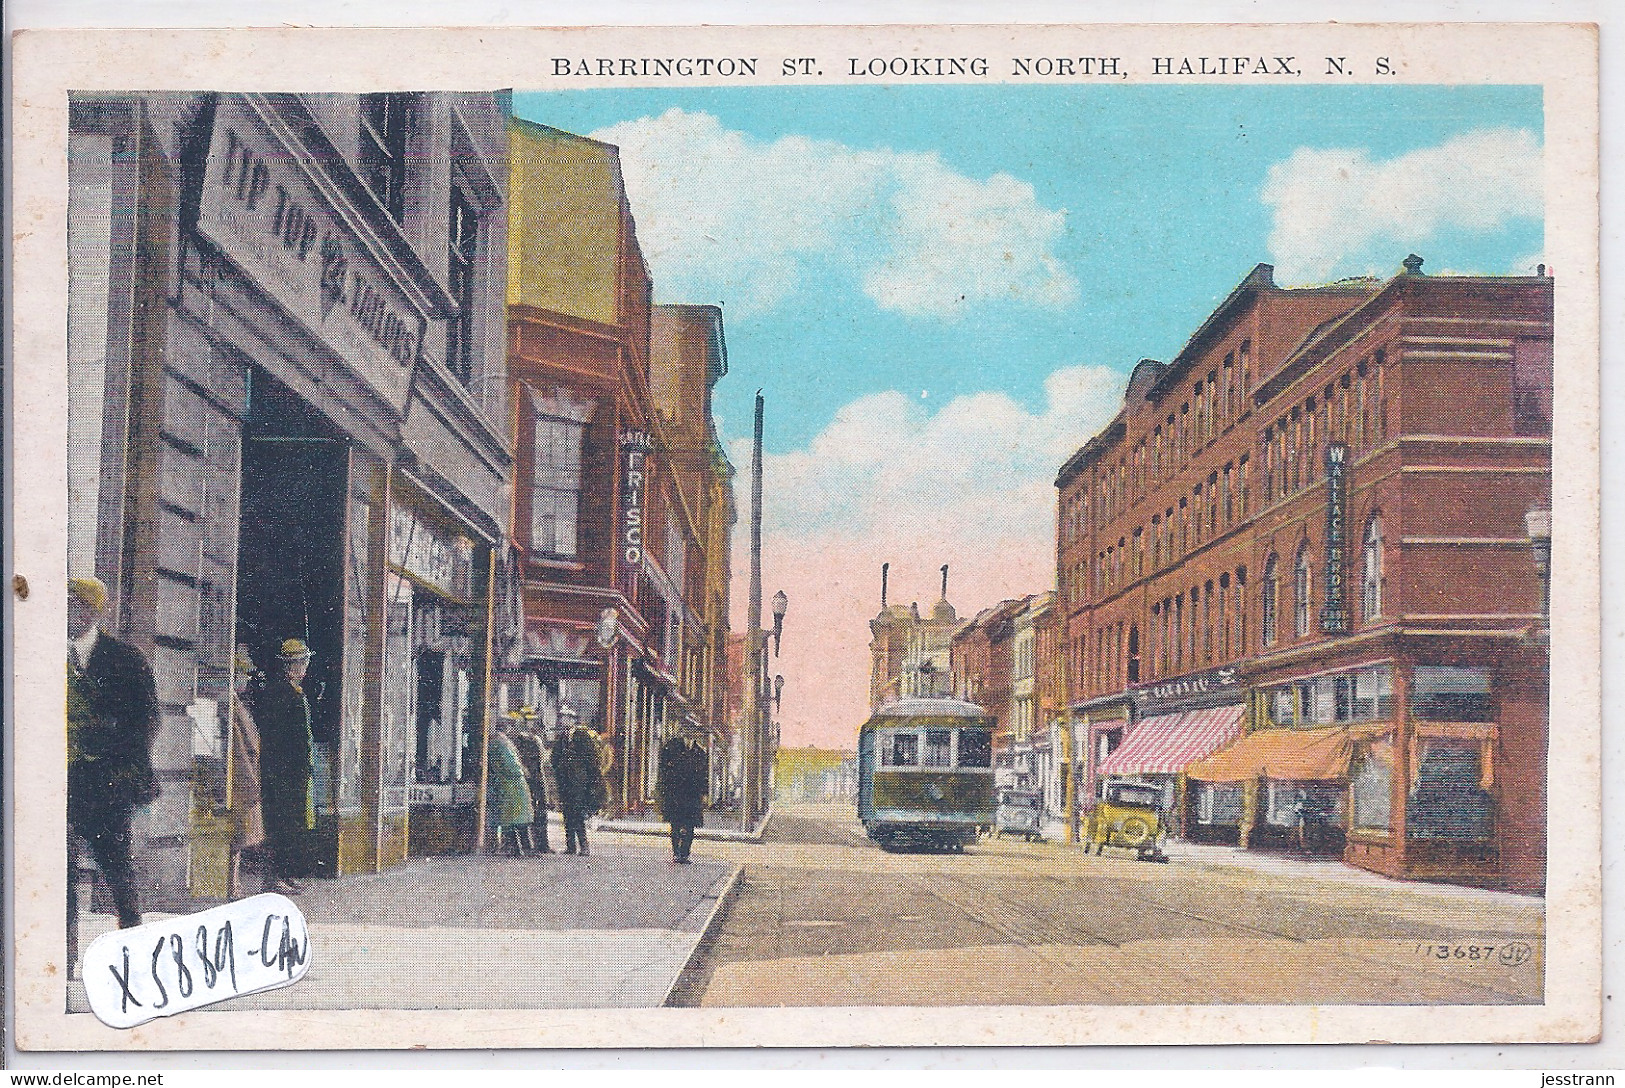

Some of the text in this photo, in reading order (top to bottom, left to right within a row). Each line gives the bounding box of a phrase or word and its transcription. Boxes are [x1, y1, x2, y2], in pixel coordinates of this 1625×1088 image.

[551, 57, 1396, 79] BARRINGTON ST. LOOKING NORTH, HALIFAX, N. S.
[223, 128, 413, 367] TIP TOP TAILORS
[625, 452, 643, 564] FRISCO
[1330, 447, 1345, 541] WALLACE
